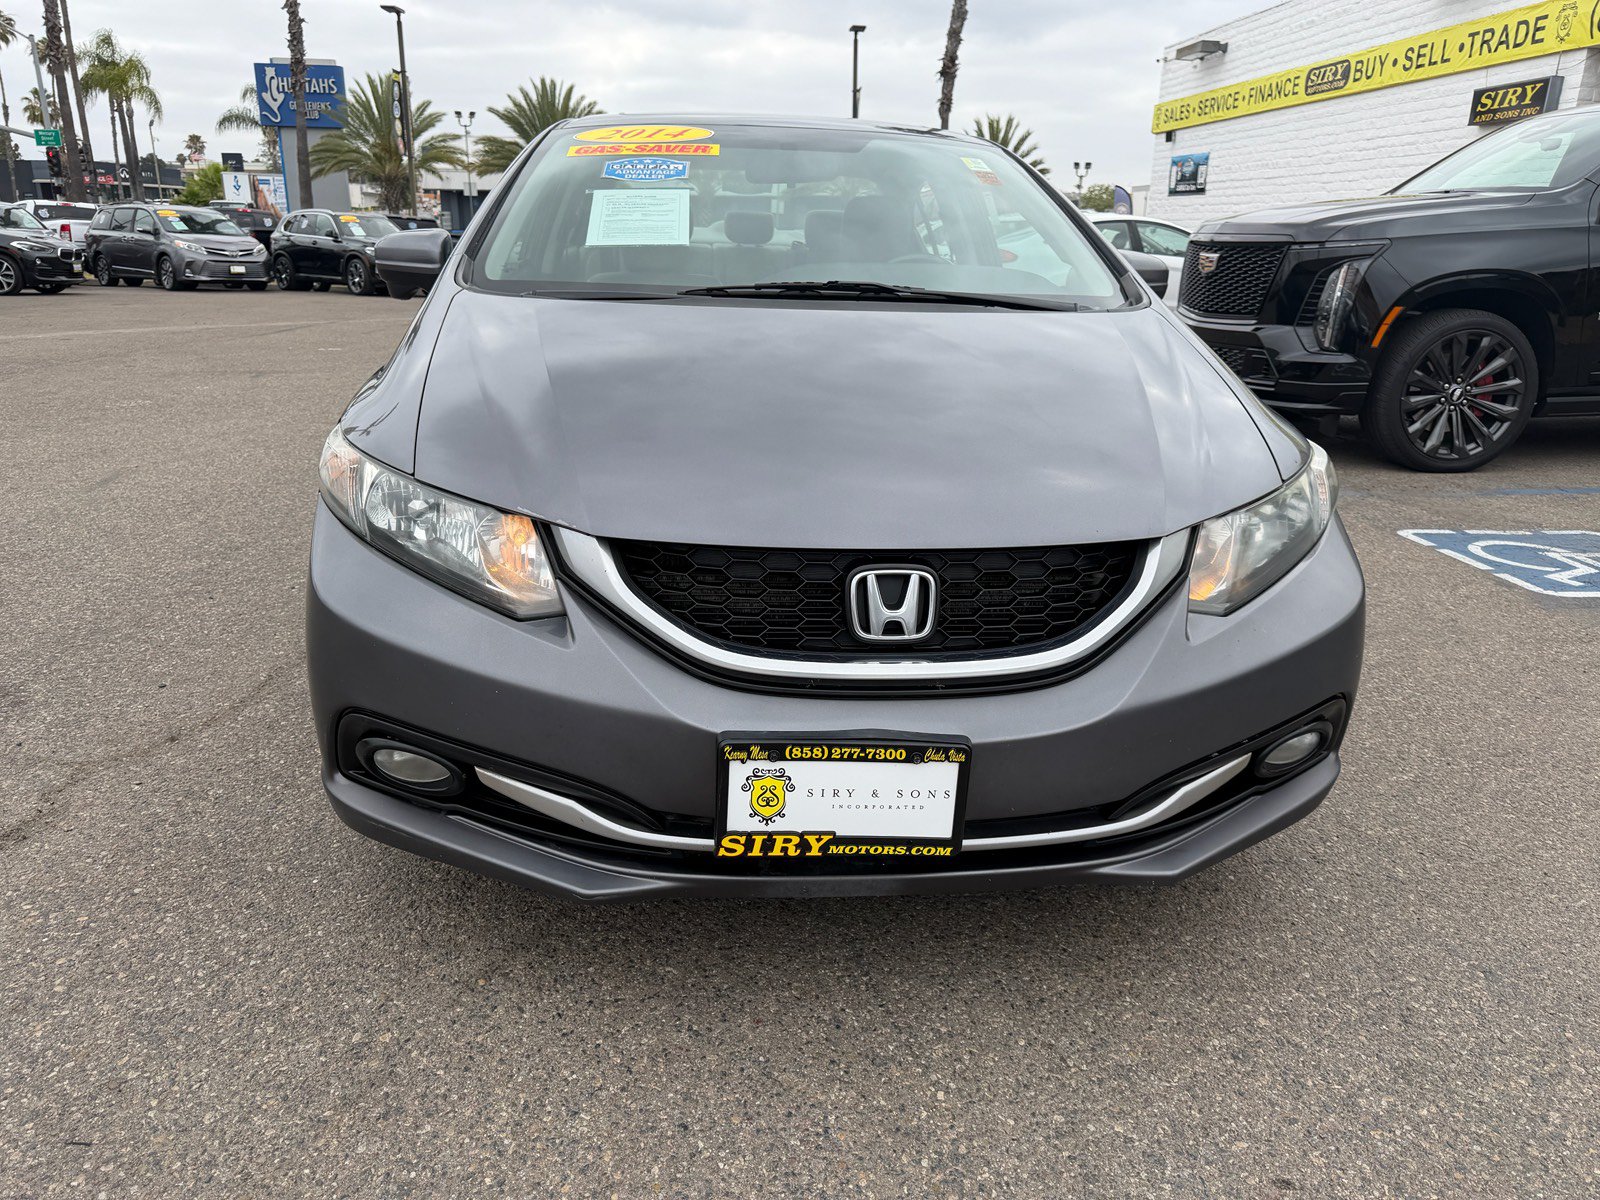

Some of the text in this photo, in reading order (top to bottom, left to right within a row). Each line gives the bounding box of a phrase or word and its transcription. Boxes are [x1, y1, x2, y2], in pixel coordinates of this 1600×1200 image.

[1352, 14, 1549, 82] BUY SELL TRADE
[1307, 62, 1349, 87] SIRY
[1163, 75, 1300, 124] SALES SERVICE FINANCE
[1476, 82, 1543, 112] SIRY
[304, 110, 319, 119] LUB
[1473, 106, 1540, 123] AND SONS INC
[595, 128, 692, 140] 2014
[574, 144, 711, 155] GAS-SAVER
[723, 744, 768, 763] Kearny Mesa
[785, 745, 907, 760] (858) 277-7300
[923, 747, 966, 763] Chula Vista
[806, 788, 951, 800] SIRY & SONS
